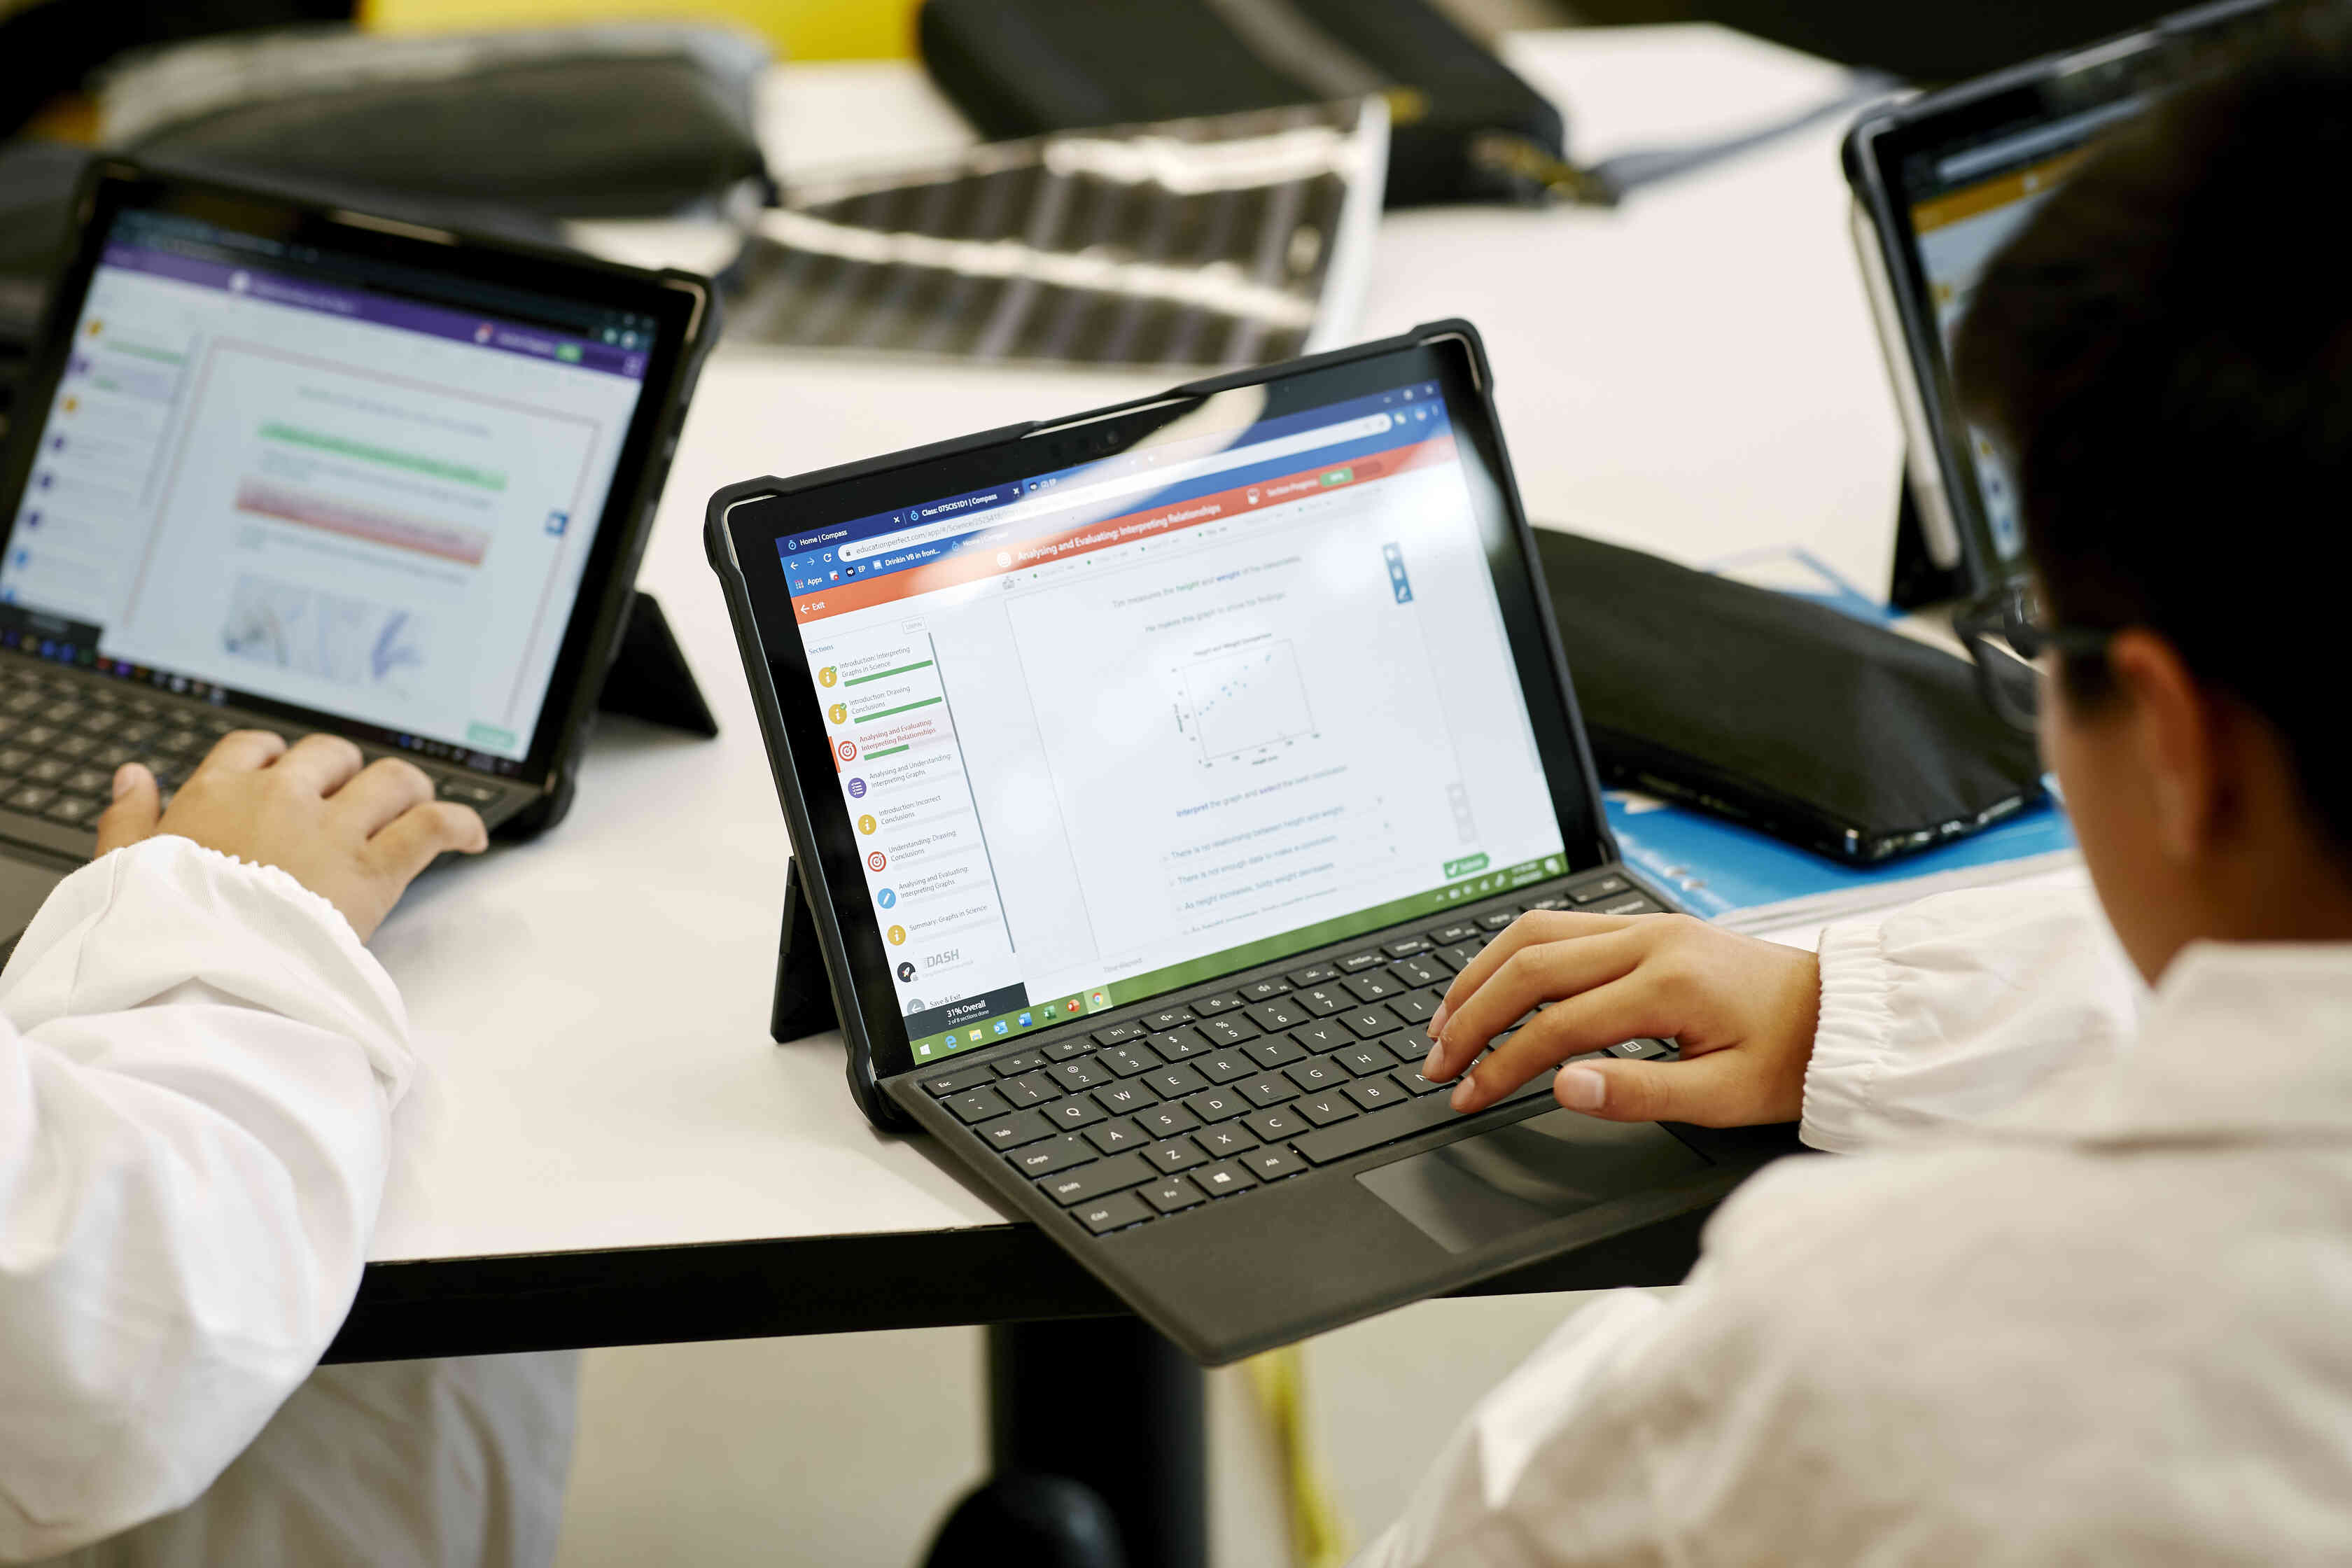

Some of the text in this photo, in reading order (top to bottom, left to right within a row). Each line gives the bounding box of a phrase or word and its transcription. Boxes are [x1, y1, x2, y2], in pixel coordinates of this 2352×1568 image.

[921, 507, 938, 517] Class:
[972, 493, 997, 506] Compass
[799, 536, 818, 546] Home
[821, 529, 848, 542] Compass
[1016, 542, 1058, 563] Analysing
[1057, 539, 1074, 551] and
[1074, 528, 1119, 548] Evaluating:
[1119, 516, 1168, 538] Interpreting
[1167, 503, 1222, 525] Relationships
[806, 576, 823, 587] Apps
[885, 556, 905, 566] Drinkin
[811, 601, 825, 610] Exit
[808, 643, 834, 655] Sections
[839, 645, 911, 669] Introduction: Interpreting
[841, 668, 862, 678] Graphs
[869, 660, 891, 671] Science
[849, 685, 911, 706] Introduction: Drawing
[851, 701, 886, 715] Conclusions
[859, 730, 888, 743] Analysing
[861, 727, 936, 752] Interpreting Relationships
[869, 767, 897, 780] Analysing
[909, 752, 951, 770] Understanding:
[871, 769, 925, 789] Interpreting Graphs
[878, 794, 941, 816] Introduction: Incorrect
[881, 811, 915, 825] Conclusions
[888, 830, 957, 853] Understanding: Drawing
[890, 848, 924, 862] Conclusions
[898, 865, 969, 891] Analysing and Evaluating:
[900, 878, 955, 899] Interpreting Graphs
[938, 912, 958, 924] Graphs
[965, 904, 987, 915] Science
[925, 948, 960, 968] DASH
[929, 998, 944, 1007] Save
[949, 993, 961, 1002] Exit
[1324, 1000, 1334, 1009] 7
[946, 1000, 986, 1018] 31% Overall
[960, 1012, 977, 1021] sections
[1363, 1016, 1377, 1025] U
[1315, 1031, 1327, 1040] Y
[1266, 1046, 1278, 1055] T
[1357, 1054, 1372, 1063] H
[1067, 1065, 1079, 1074] @
[1217, 1062, 1231, 1070] R
[1310, 1070, 1323, 1078] G
[1168, 1077, 1181, 1085] E
[1260, 1085, 1271, 1093] F
[1367, 1088, 1380, 1097] B
[1114, 1091, 1132, 1102] W
[1210, 1100, 1224, 1110] D
[1317, 1103, 1329, 1112] V
[1066, 1107, 1082, 1116] Q
[1160, 1115, 1172, 1124] S
[1270, 1119, 1282, 1128] C
[994, 1128, 1012, 1138] Tab
[1110, 1131, 1124, 1141] A
[1217, 1134, 1232, 1144] X
[1026, 1155, 1049, 1166] Caps
[1166, 1149, 1181, 1161] Z
[1266, 1158, 1280, 1167] Alt
[1058, 1182, 1082, 1193] Shift
[1090, 1210, 1109, 1222] Ctrl
